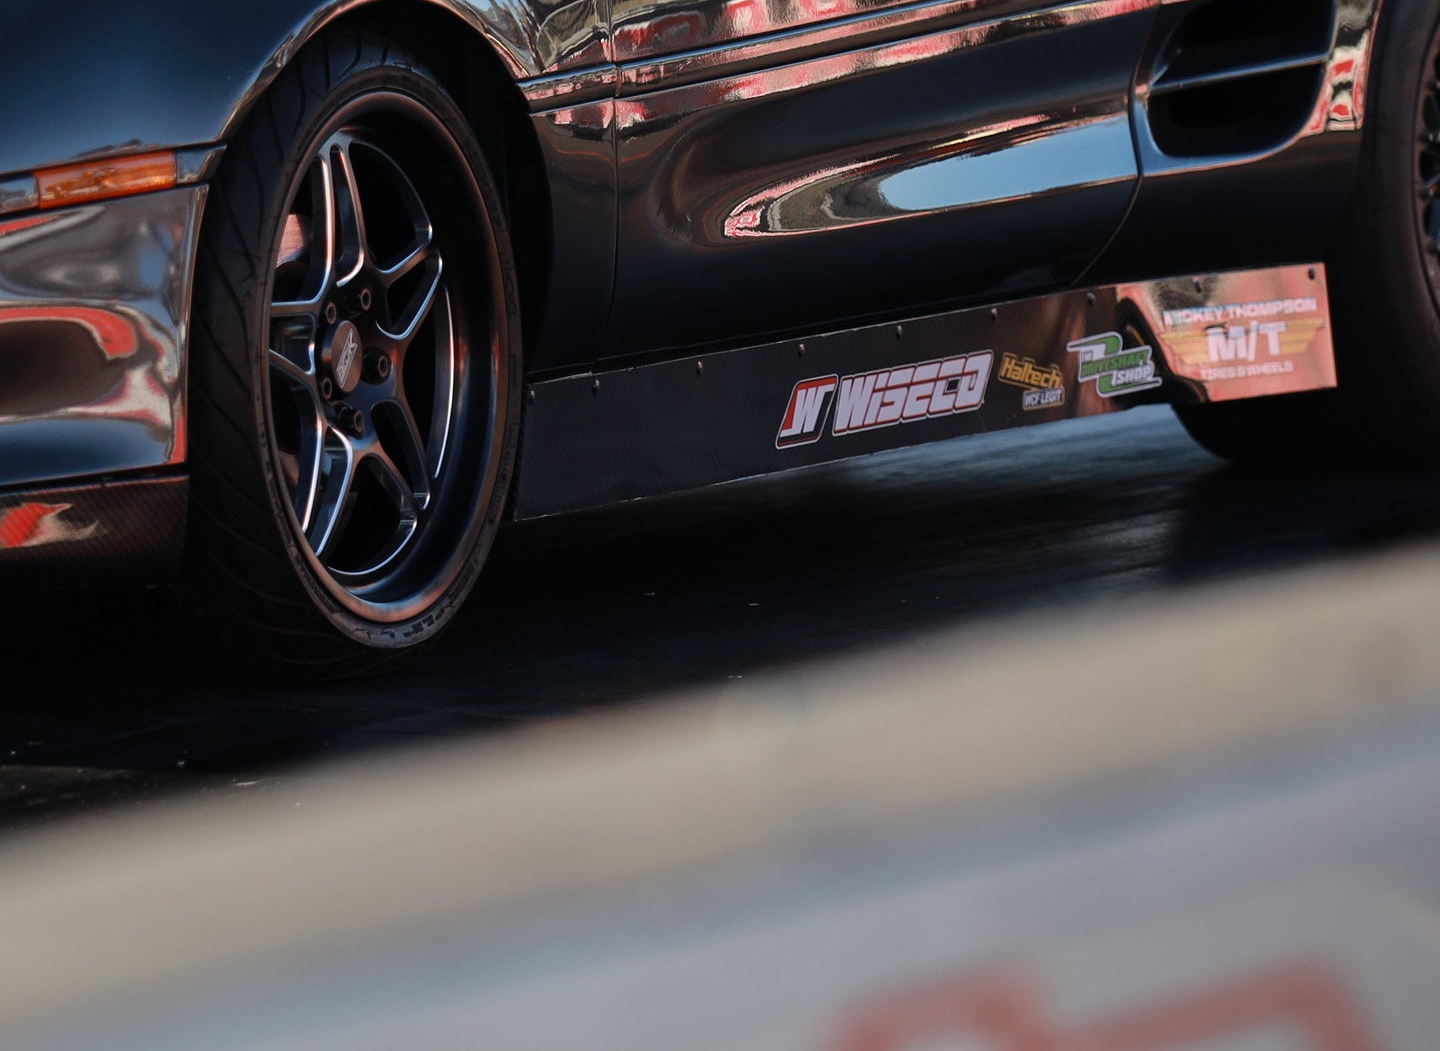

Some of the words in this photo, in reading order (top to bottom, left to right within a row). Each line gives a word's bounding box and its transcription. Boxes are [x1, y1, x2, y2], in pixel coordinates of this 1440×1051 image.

[1162, 305, 1224, 327] MICKEY
[1226, 296, 1318, 319] THOMPSON
[1205, 320, 1287, 363] M/T
[1000, 355, 1063, 388] Haltech
[1200, 365, 1237, 381] TIRES
[1246, 361, 1294, 377] WHEELS
